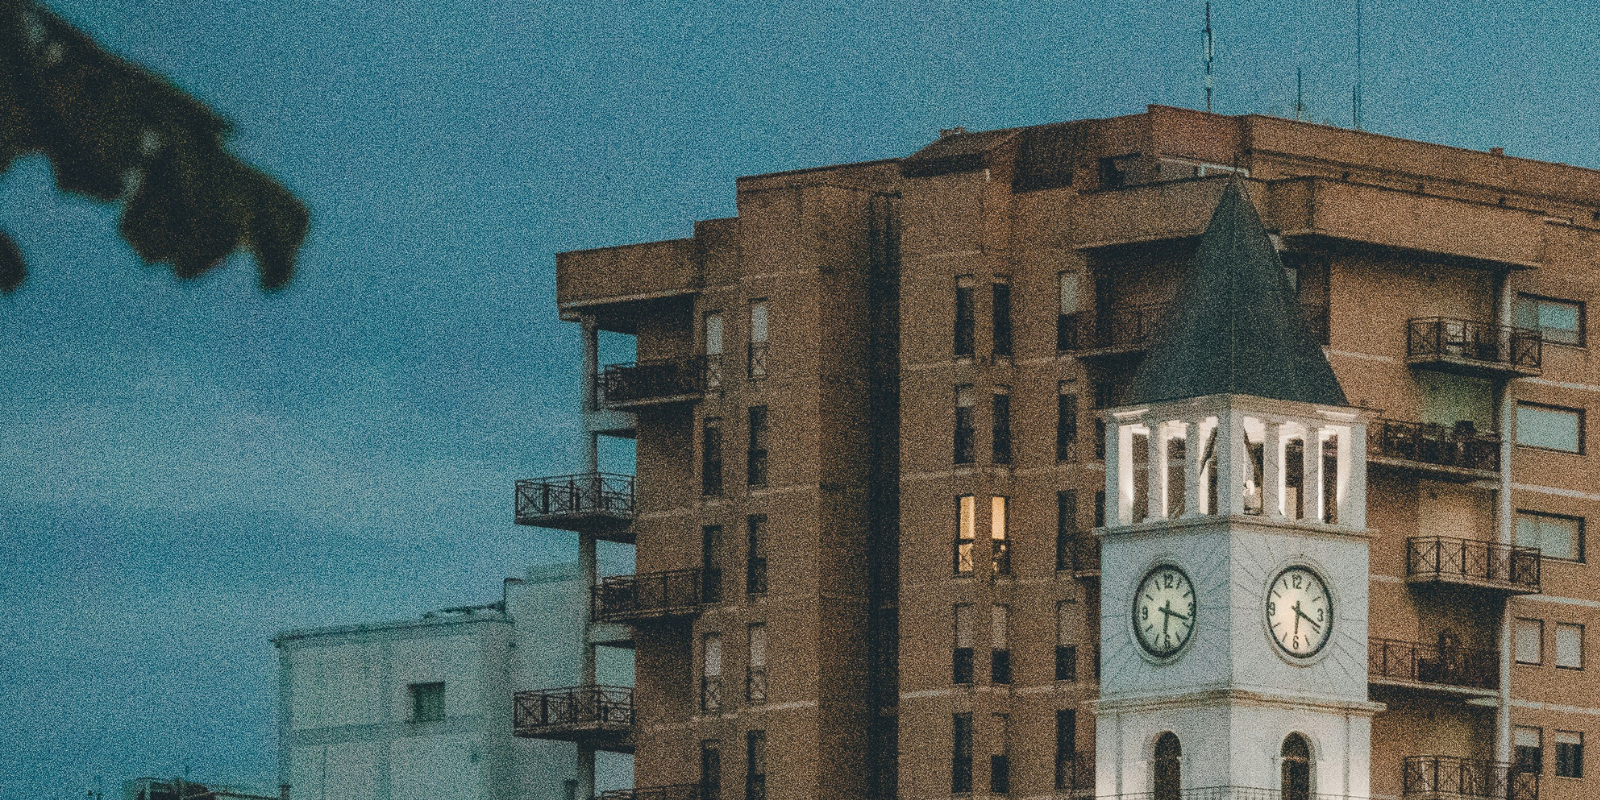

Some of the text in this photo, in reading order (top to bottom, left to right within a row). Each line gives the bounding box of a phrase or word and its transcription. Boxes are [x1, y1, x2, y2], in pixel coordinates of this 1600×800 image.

[1163, 573, 1174, 589] 12
[1292, 573, 1302, 589] 12
[1141, 607, 1149, 620] 9
[1269, 602, 1276, 616] 9
[1317, 608, 1324, 621] 3
[1292, 635, 1300, 649] 6
